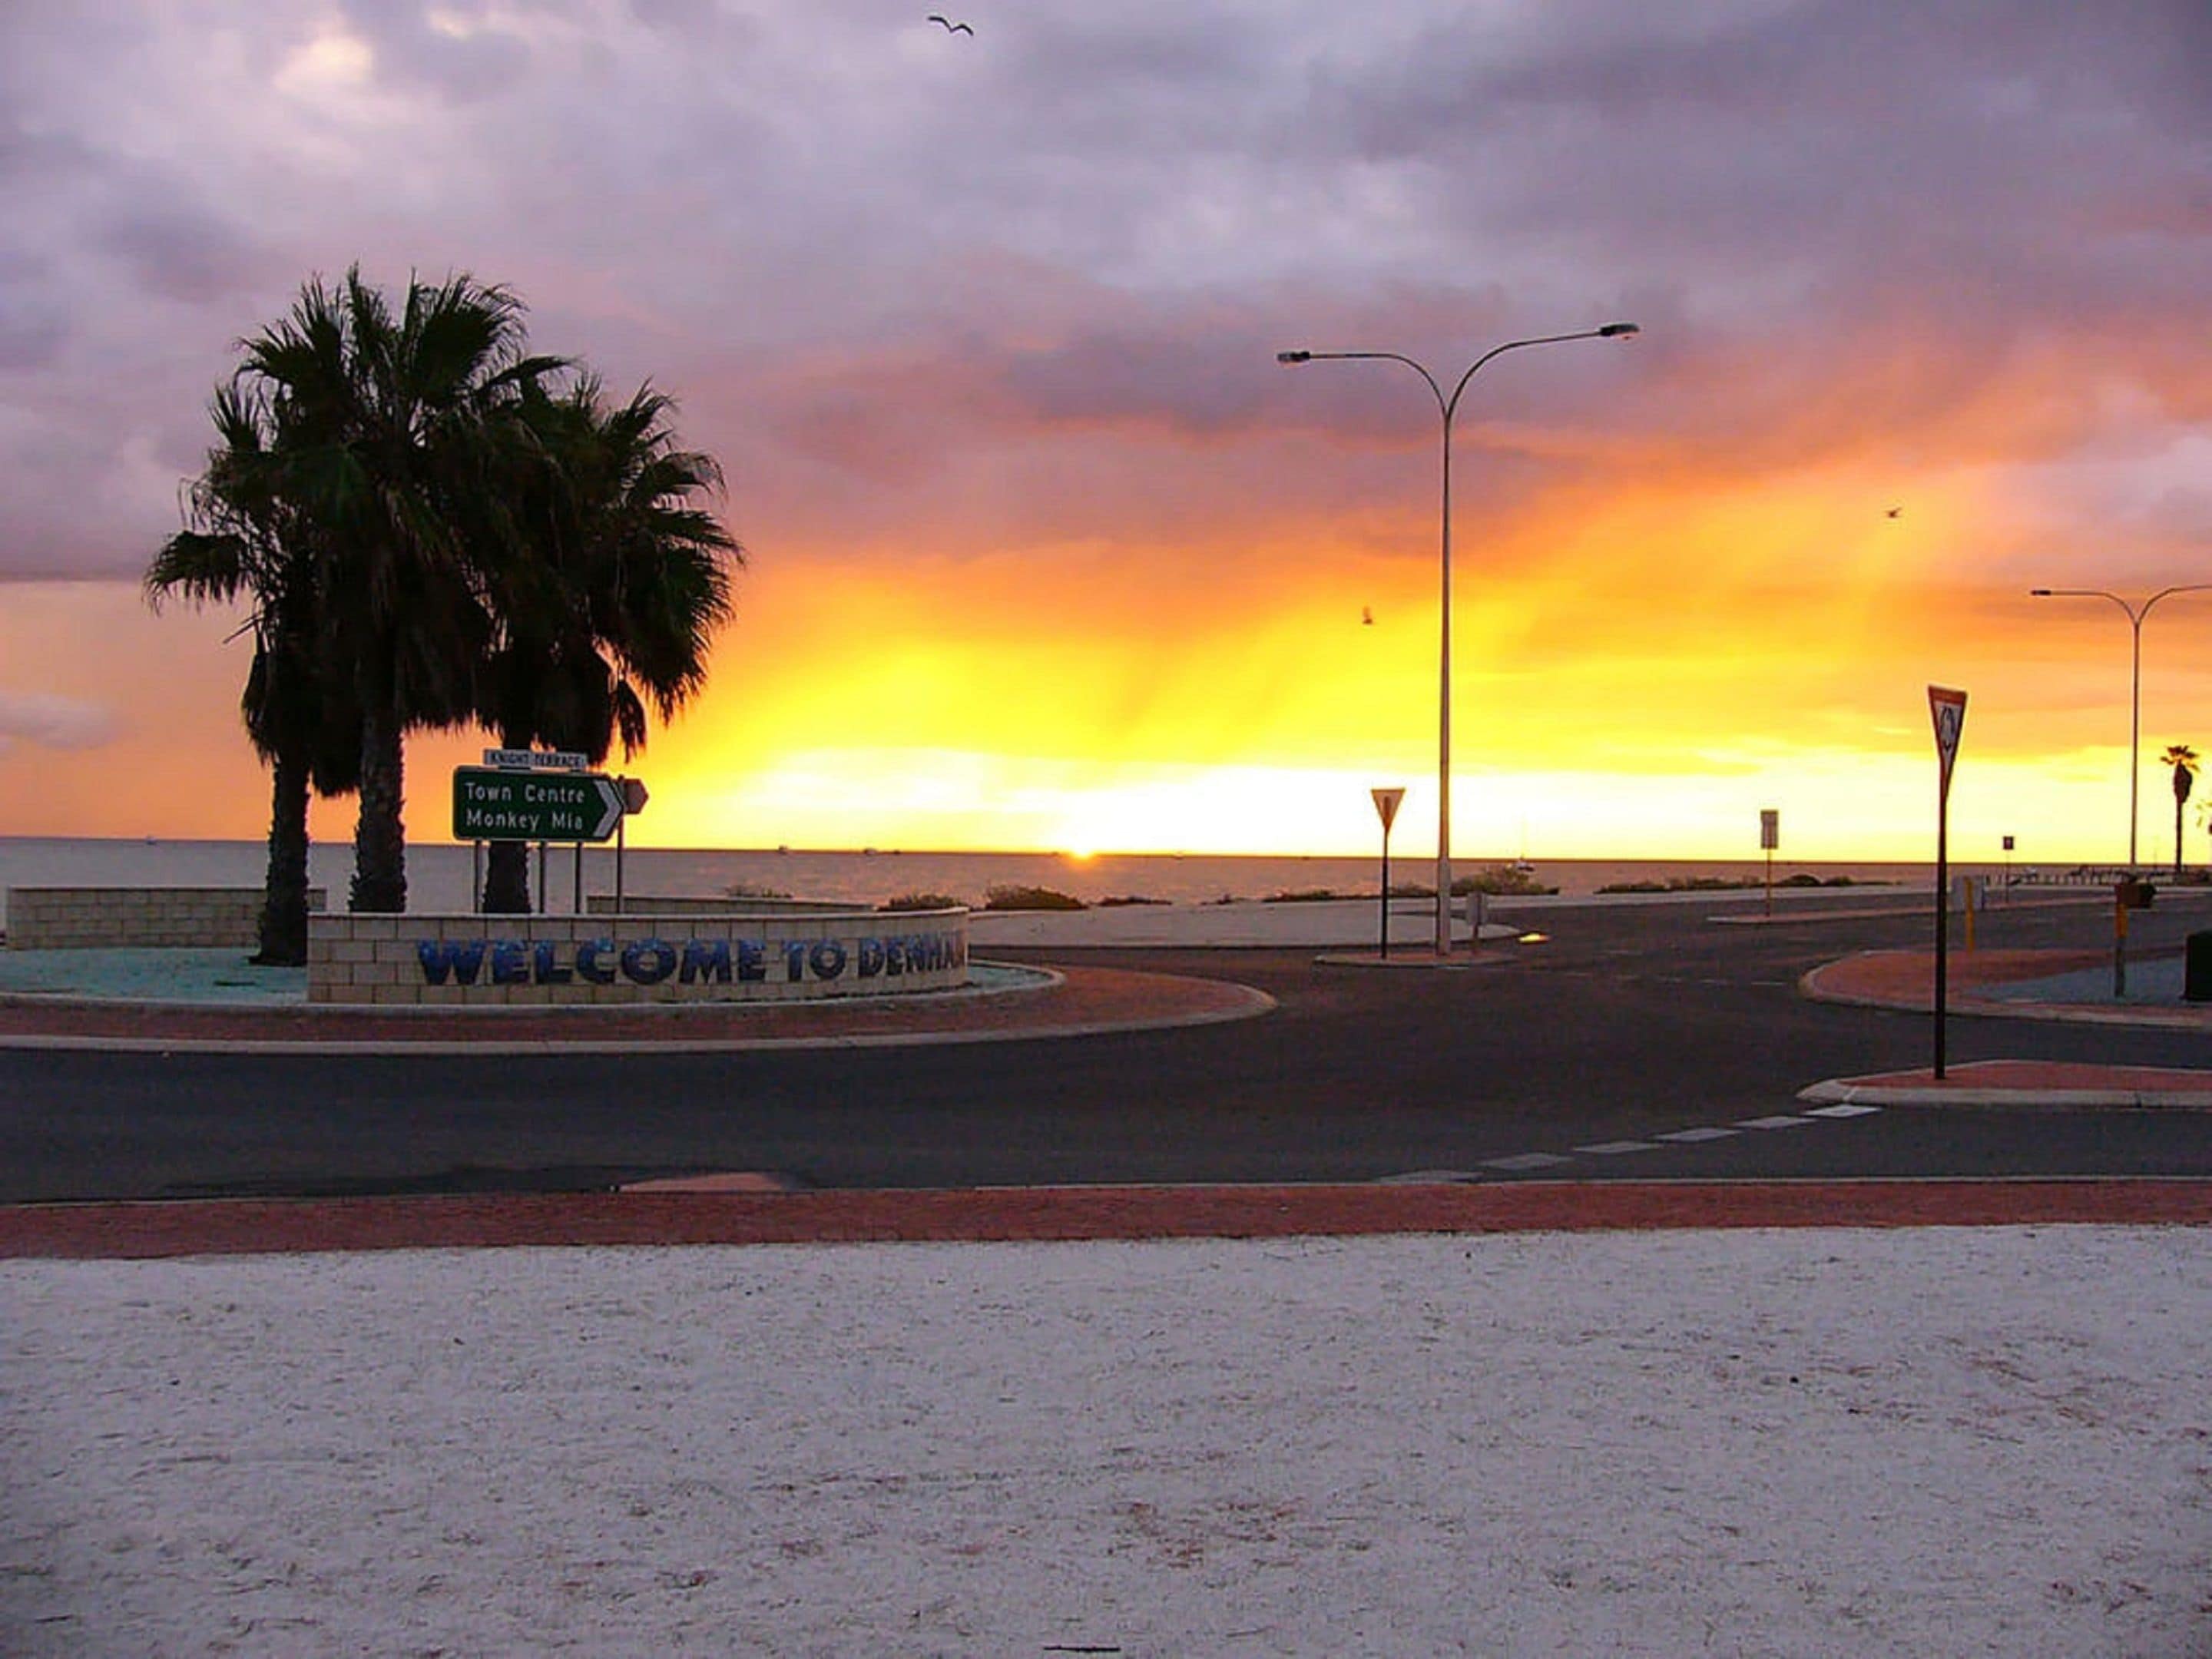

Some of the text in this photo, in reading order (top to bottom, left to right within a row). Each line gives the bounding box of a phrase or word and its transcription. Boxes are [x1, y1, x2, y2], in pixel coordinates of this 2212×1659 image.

[465, 782, 585, 803] Town Centre
[465, 809, 583, 833] Monkey Mia
[416, 937, 767, 985] WELCOME
[782, 937, 846, 980] TO
